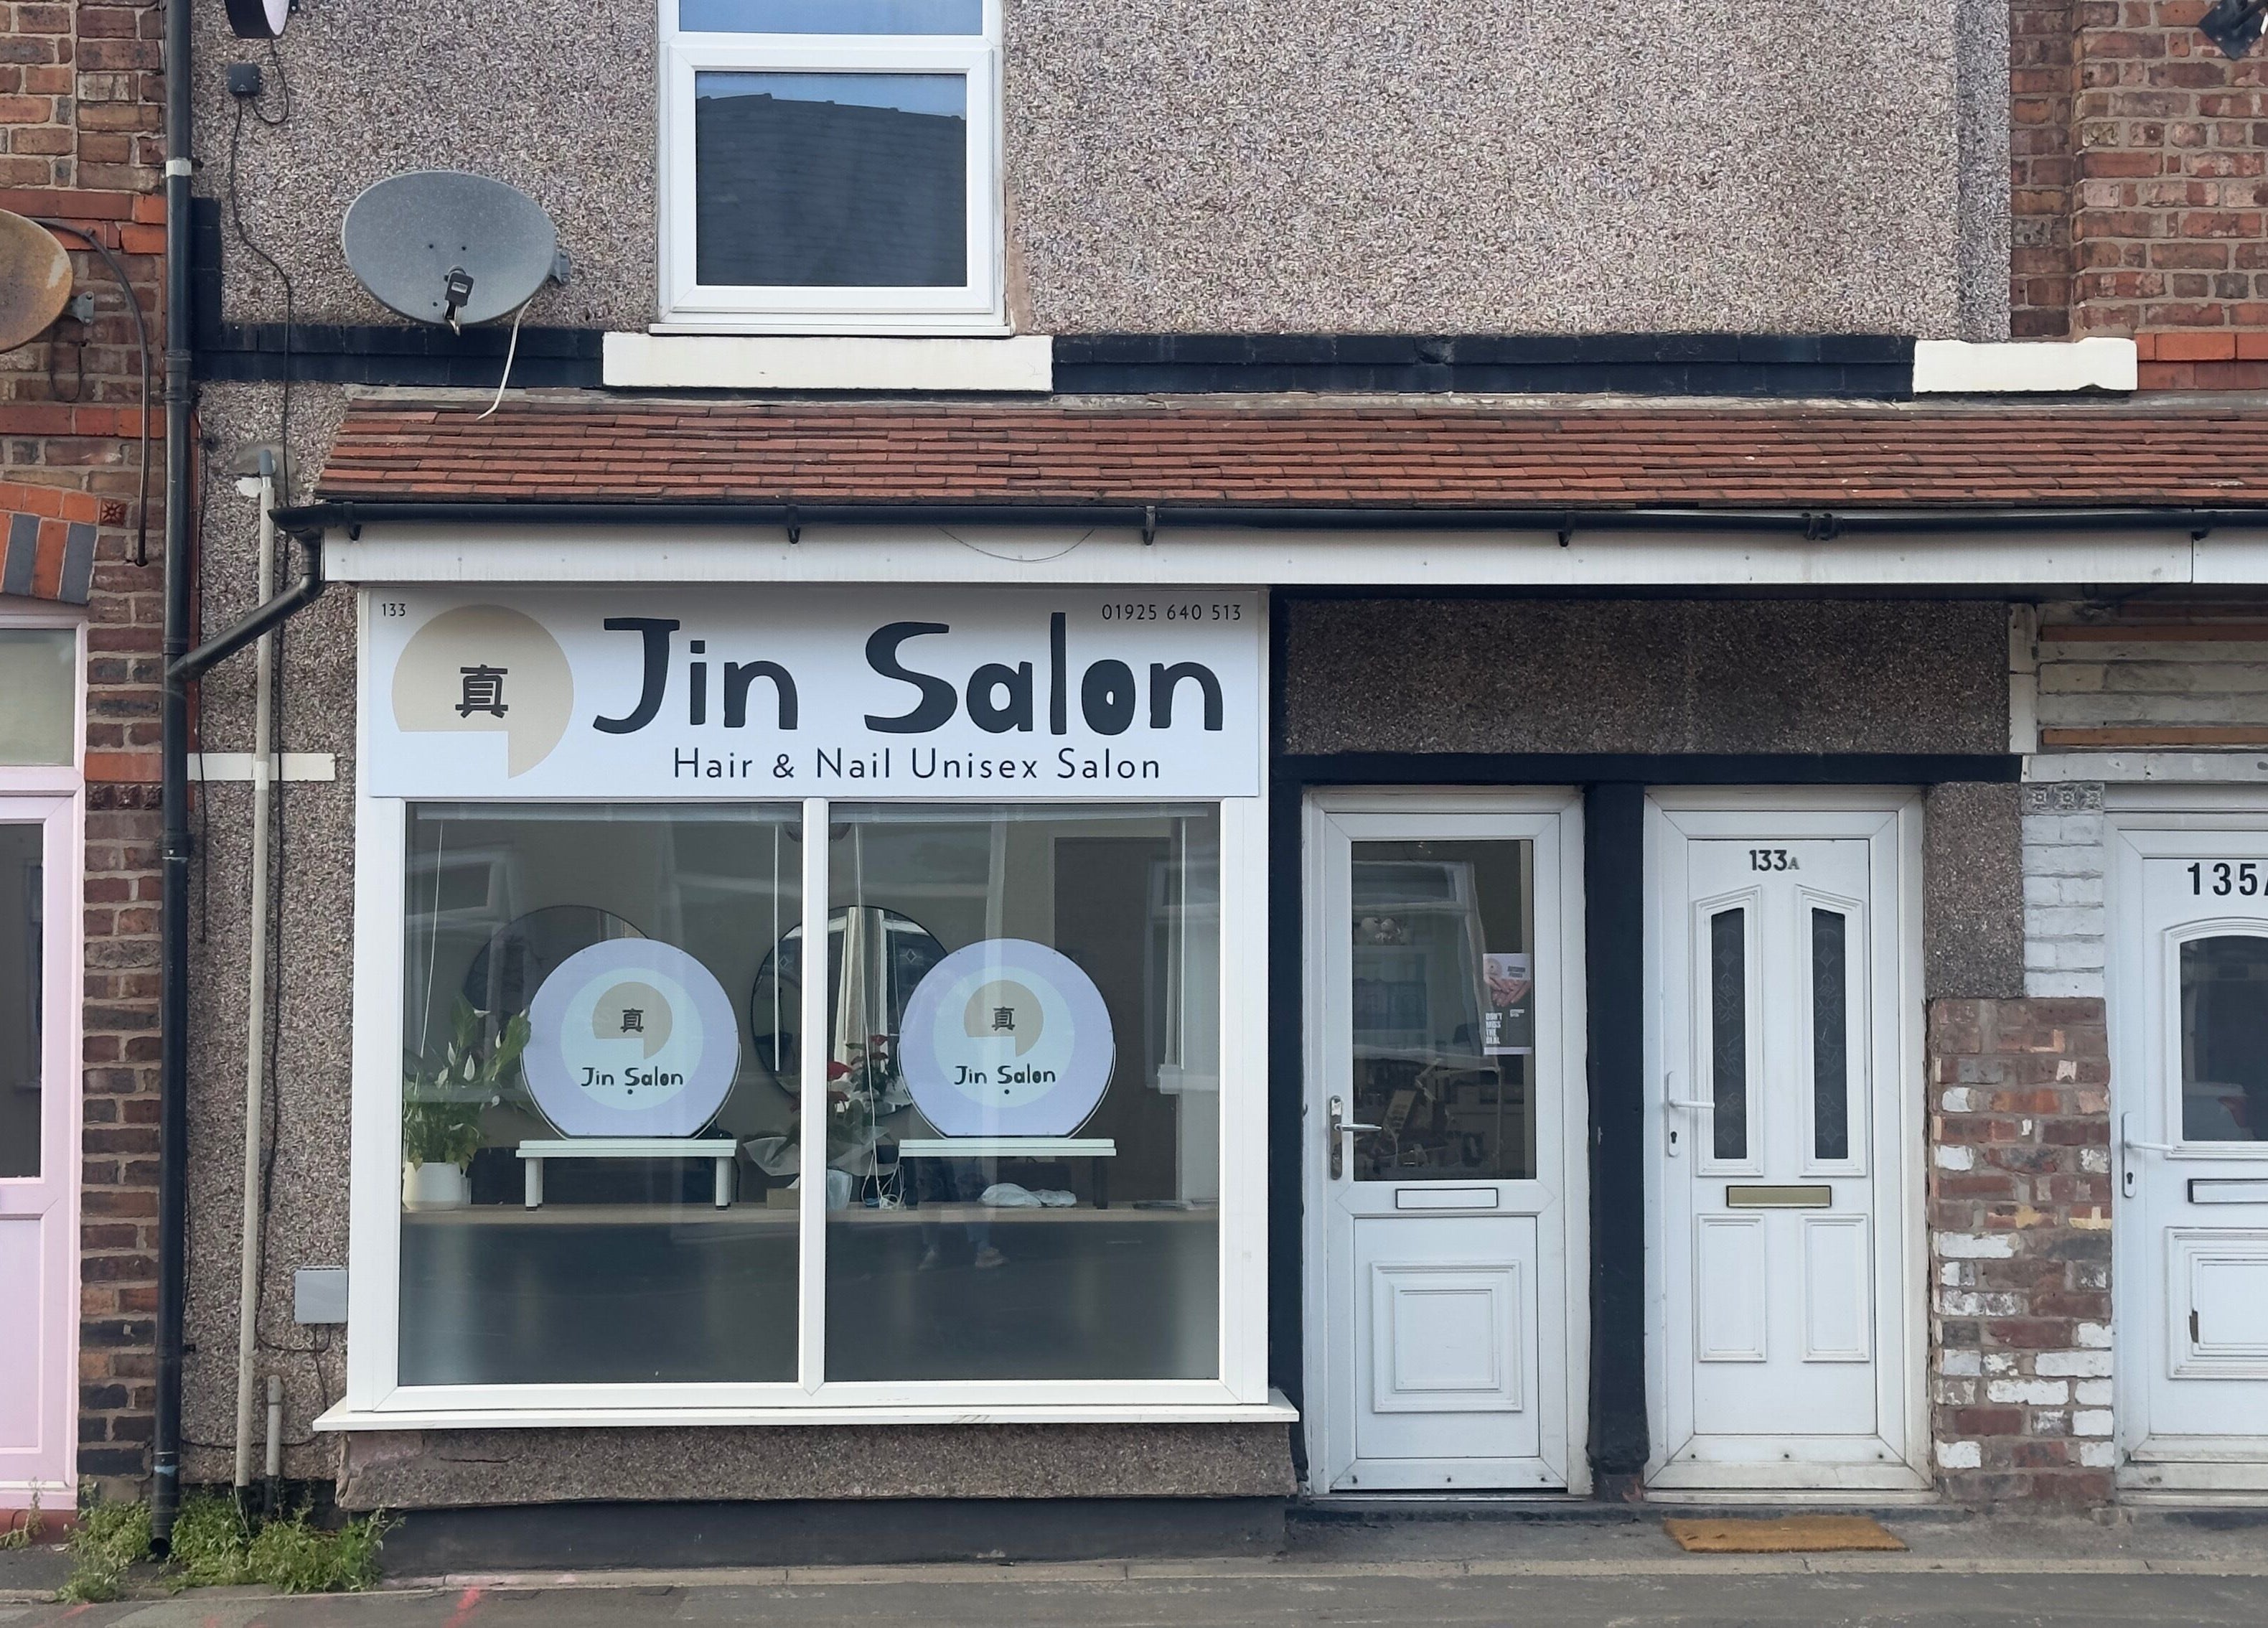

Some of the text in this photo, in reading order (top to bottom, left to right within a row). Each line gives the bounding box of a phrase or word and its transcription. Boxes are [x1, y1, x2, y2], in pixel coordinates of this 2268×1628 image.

[381, 602, 406, 617] 133
[1102, 604, 1241, 621] 01925 640 513
[593, 612, 1223, 735] Jin Salon
[454, 663, 509, 719] 真
[674, 747, 1160, 779] Hair & Nail Unisex Salon
[1749, 849, 1800, 871] 133A
[2187, 862, 2268, 896] 135
[620, 1008, 645, 1033] 真
[991, 1006, 1016, 1031] 真
[581, 1065, 683, 1087] Jin Salon
[954, 1063, 1056, 1085] Jin Salon
